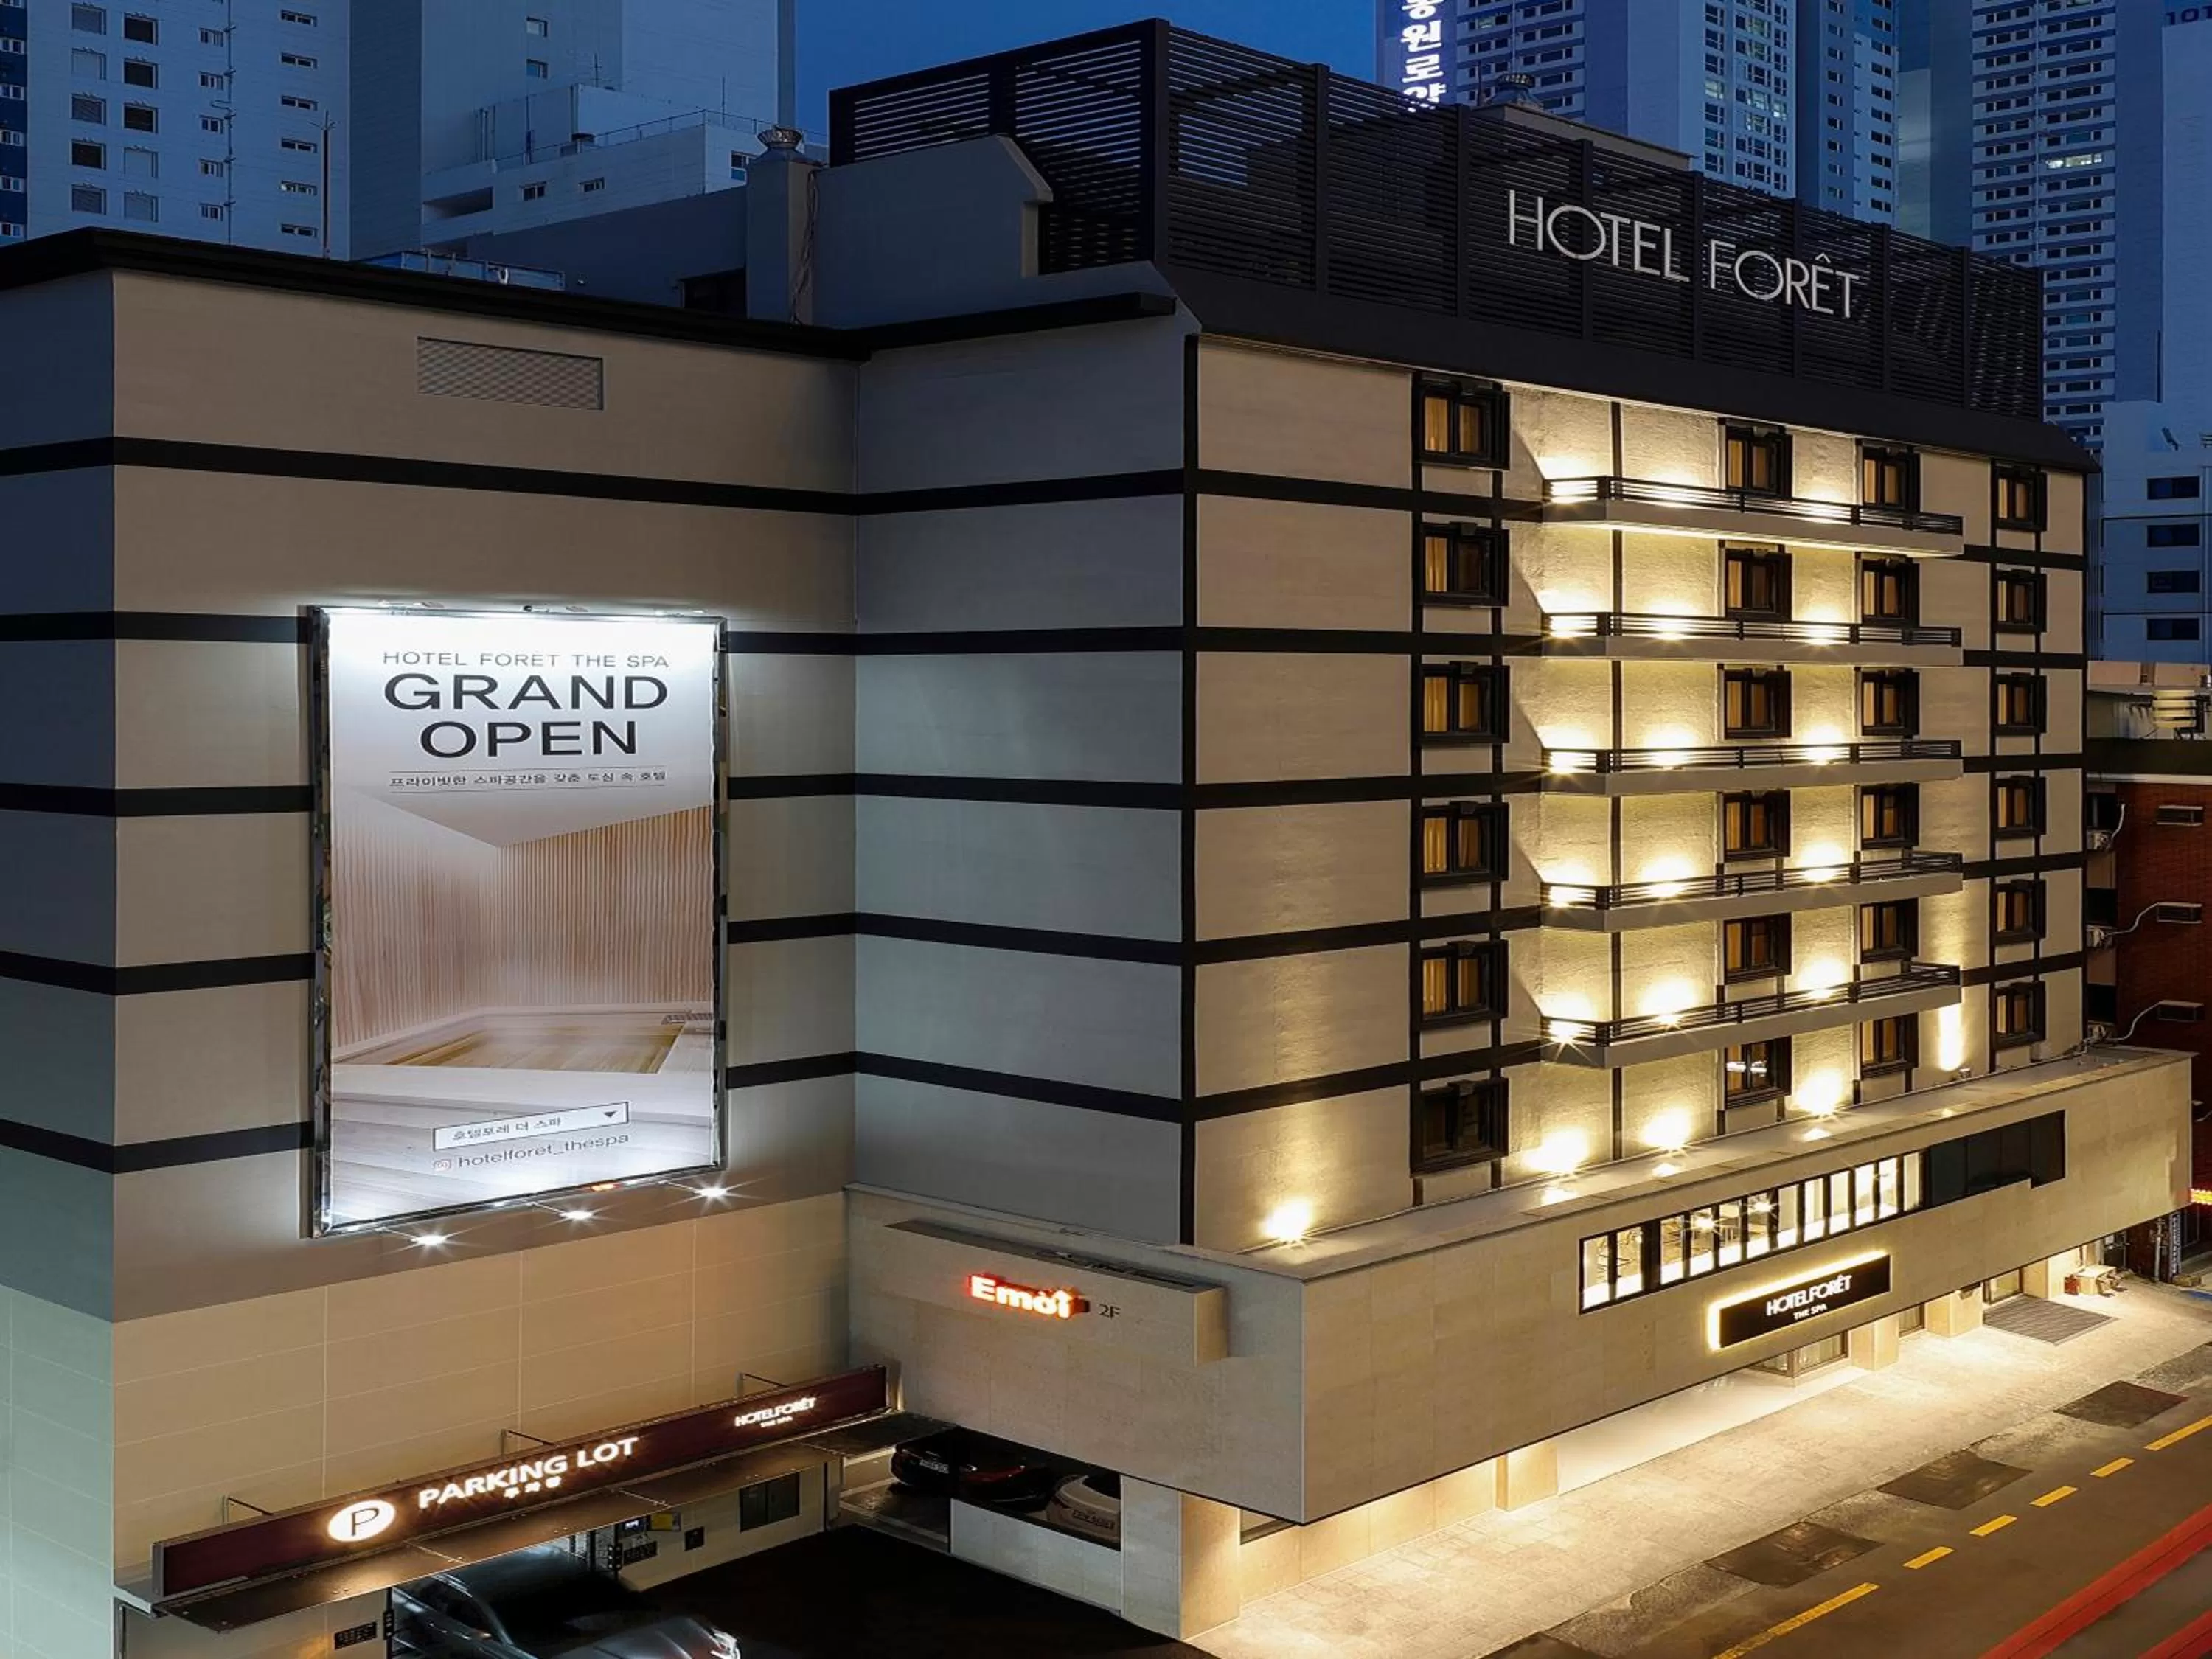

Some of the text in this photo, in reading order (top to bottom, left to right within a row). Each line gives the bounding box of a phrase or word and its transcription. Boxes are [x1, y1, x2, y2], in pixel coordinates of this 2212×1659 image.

[1509, 189, 1860, 319] HOTEL FORÊT
[383, 650, 669, 668] HOTEL FORET THE SPA
[383, 672, 669, 711] GRAND
[420, 720, 637, 758] OPEN
[389, 775, 467, 787] 프라이빗한
[1098, 1304, 1121, 1320] 2F
[1793, 1303, 1827, 1320] THE SPA
[349, 1506, 380, 1537] P
[418, 1454, 568, 1510] PARKING
[577, 1436, 640, 1468] LOT
